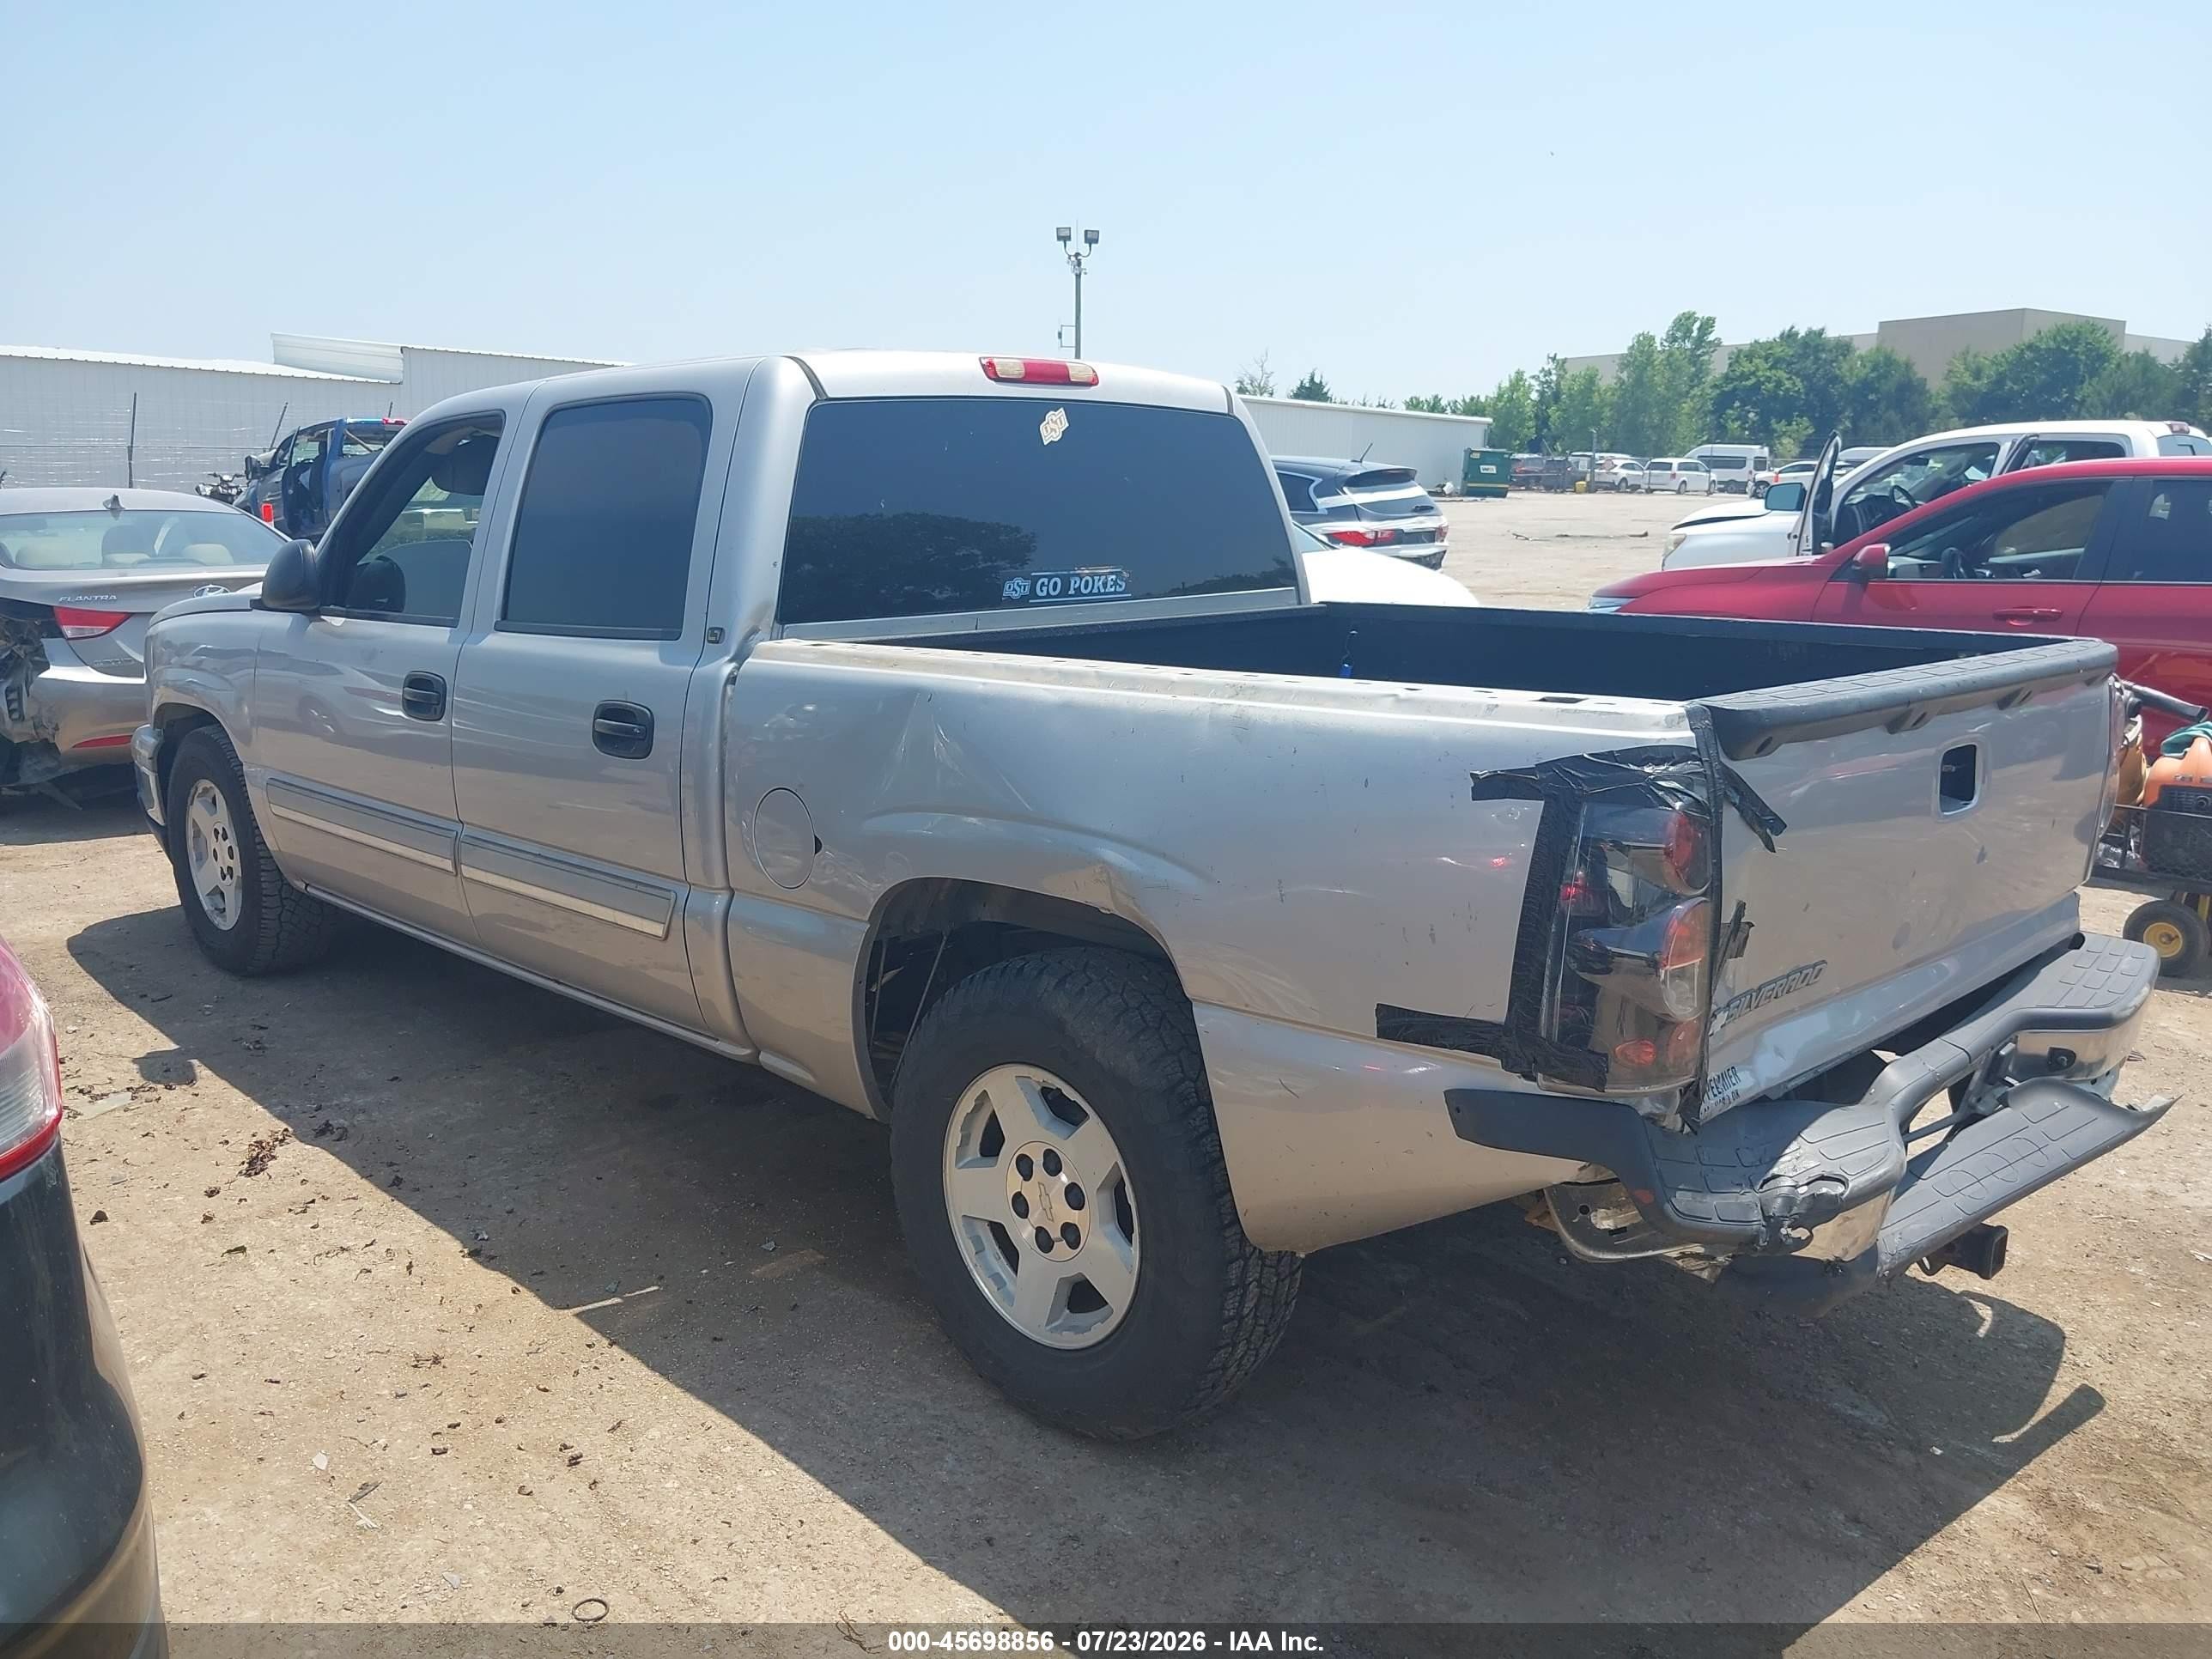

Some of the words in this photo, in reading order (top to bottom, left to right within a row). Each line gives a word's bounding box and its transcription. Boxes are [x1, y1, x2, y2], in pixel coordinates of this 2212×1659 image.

[1041, 409, 1068, 444] OSU
[1004, 578, 1030, 599] OSU
[1036, 577, 1061, 597] GO
[1068, 574, 1127, 595] POKES
[1725, 958, 1828, 1025] SILVERADO
